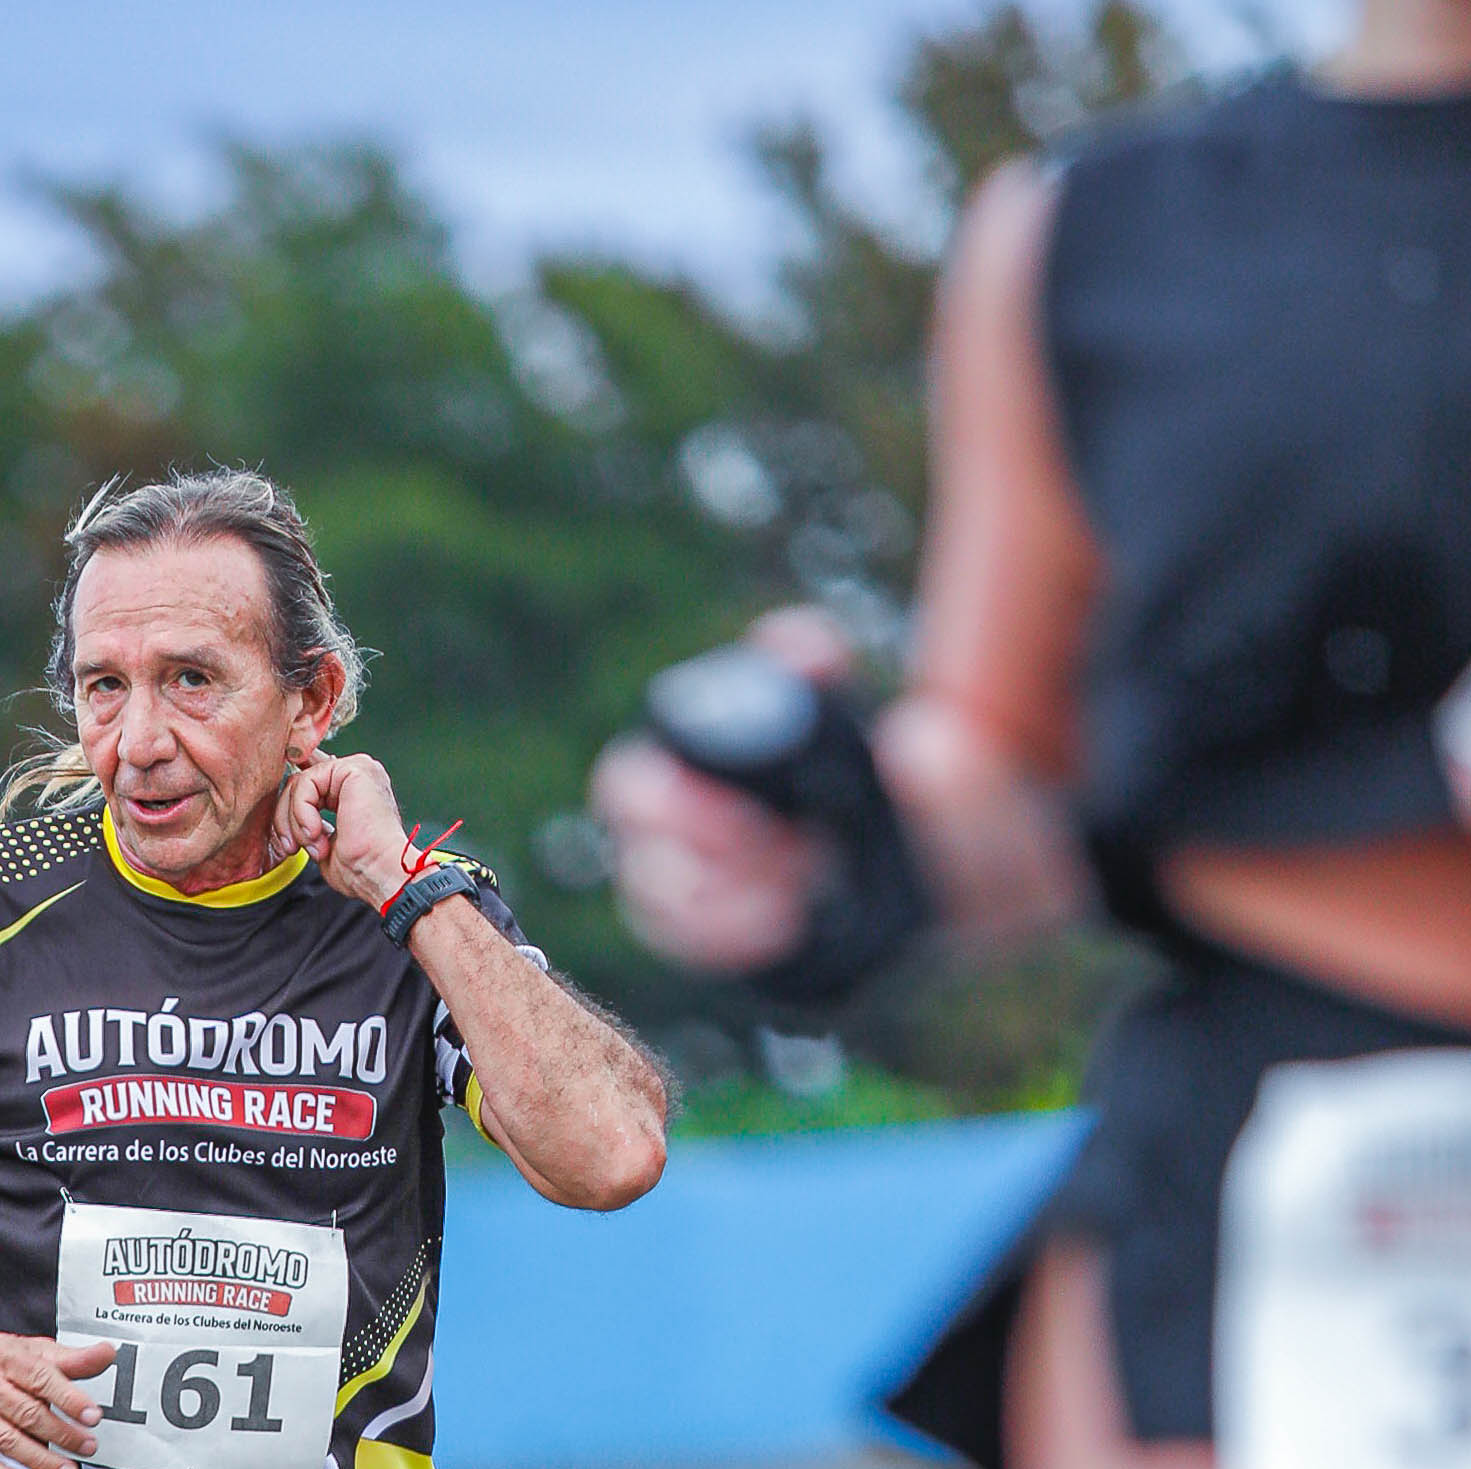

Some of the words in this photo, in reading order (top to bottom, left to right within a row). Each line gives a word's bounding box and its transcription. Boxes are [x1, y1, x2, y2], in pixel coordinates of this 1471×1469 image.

[25, 997, 387, 1084] AUTÓDROMO
[80, 1080, 232, 1126] RUNNING
[243, 1089, 336, 1132] RACE
[16, 1140, 38, 1162] La
[42, 1140, 119, 1163] Carrera
[125, 1139, 152, 1162] de
[159, 1139, 188, 1162] los
[194, 1141, 265, 1166] Clubes
[271, 1146, 304, 1169] del
[310, 1145, 397, 1169] Noroeste
[103, 1227, 308, 1289] AUTÓDROMO
[95, 1307, 108, 1319] La
[111, 1309, 153, 1324] Carrera
[155, 1313, 170, 1325] de
[173, 1314, 190, 1326] los
[193, 1315, 231, 1329] Clubes
[233, 1319, 251, 1331] del
[253, 1320, 302, 1333] Noroeste
[133, 1283, 218, 1305] RUNNING
[223, 1285, 272, 1312] RACE
[99, 1342, 283, 1432] 161
